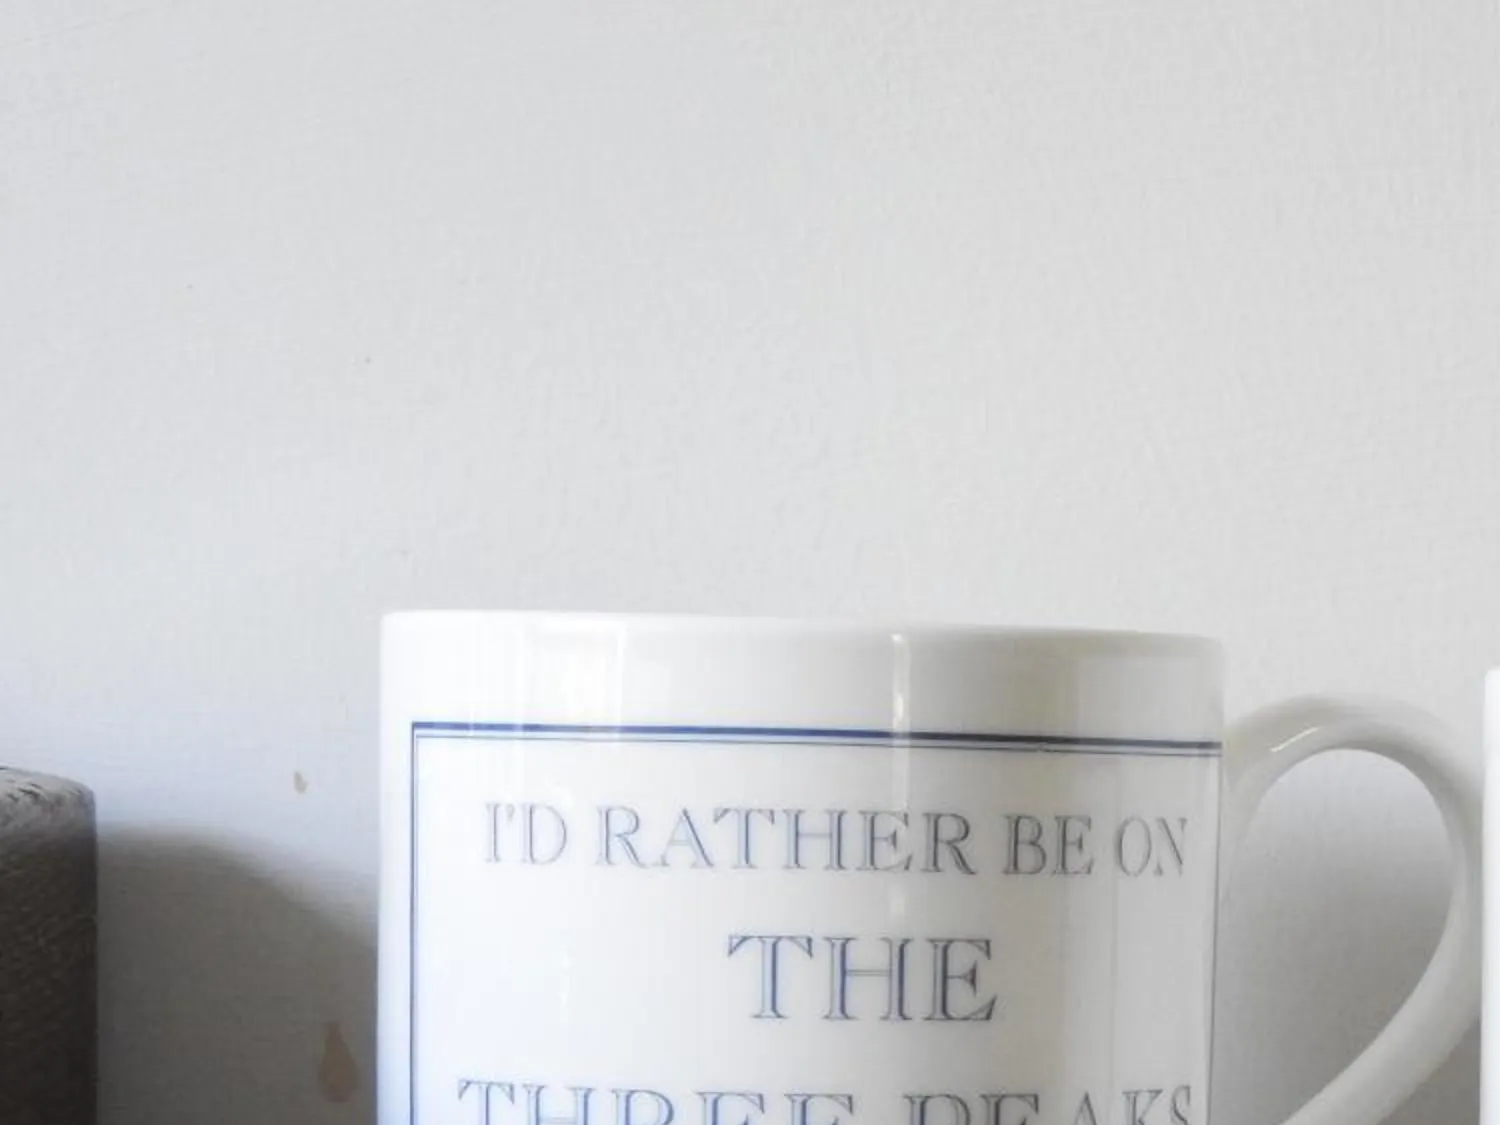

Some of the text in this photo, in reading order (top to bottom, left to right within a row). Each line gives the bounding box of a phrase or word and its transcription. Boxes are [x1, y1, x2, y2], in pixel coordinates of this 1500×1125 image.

[484, 802, 1187, 877] I'D RATHER BE ON
[726, 934, 998, 1022] THE
